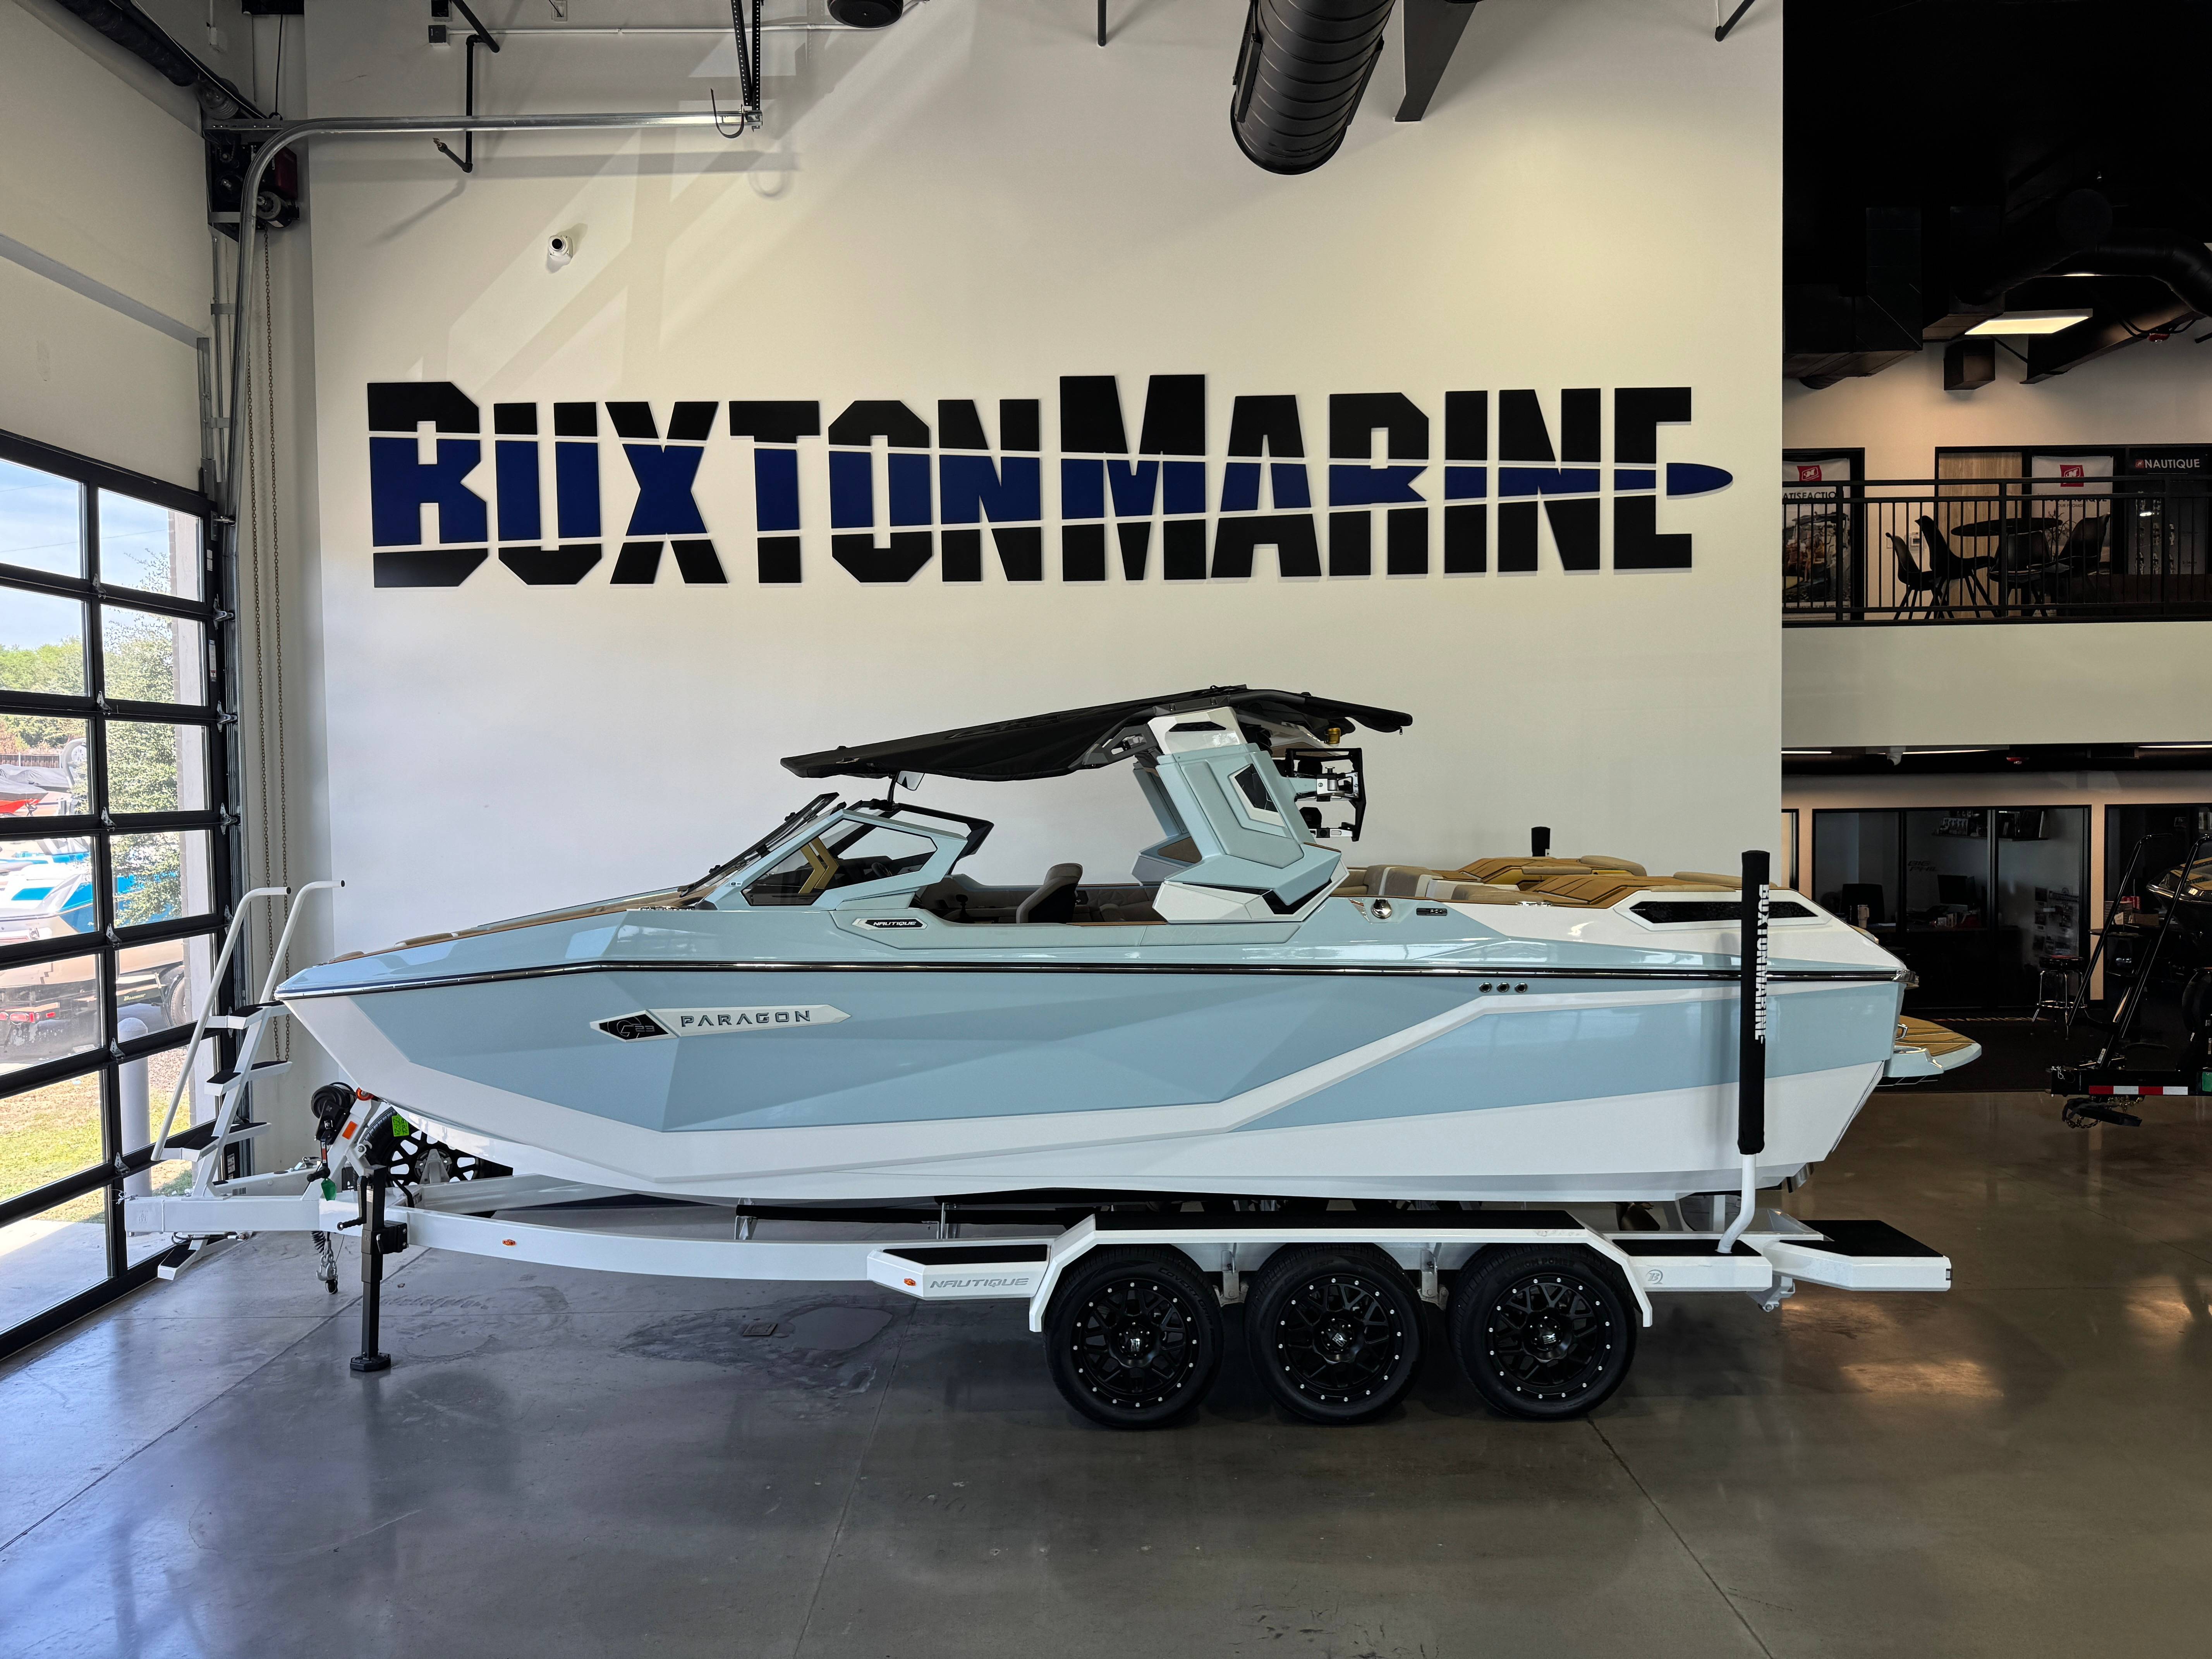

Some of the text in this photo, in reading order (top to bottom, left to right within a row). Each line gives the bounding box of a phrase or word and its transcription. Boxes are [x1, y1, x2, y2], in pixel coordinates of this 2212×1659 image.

[2145, 459, 2200, 469] NAUTIQUE
[368, 374, 1692, 587] BUXTONMARINE
[681, 1009, 811, 1027] PARAGON
[930, 1278, 1029, 1288] NAUTIQUE
[1158, 1266, 1200, 1297] COVERT
